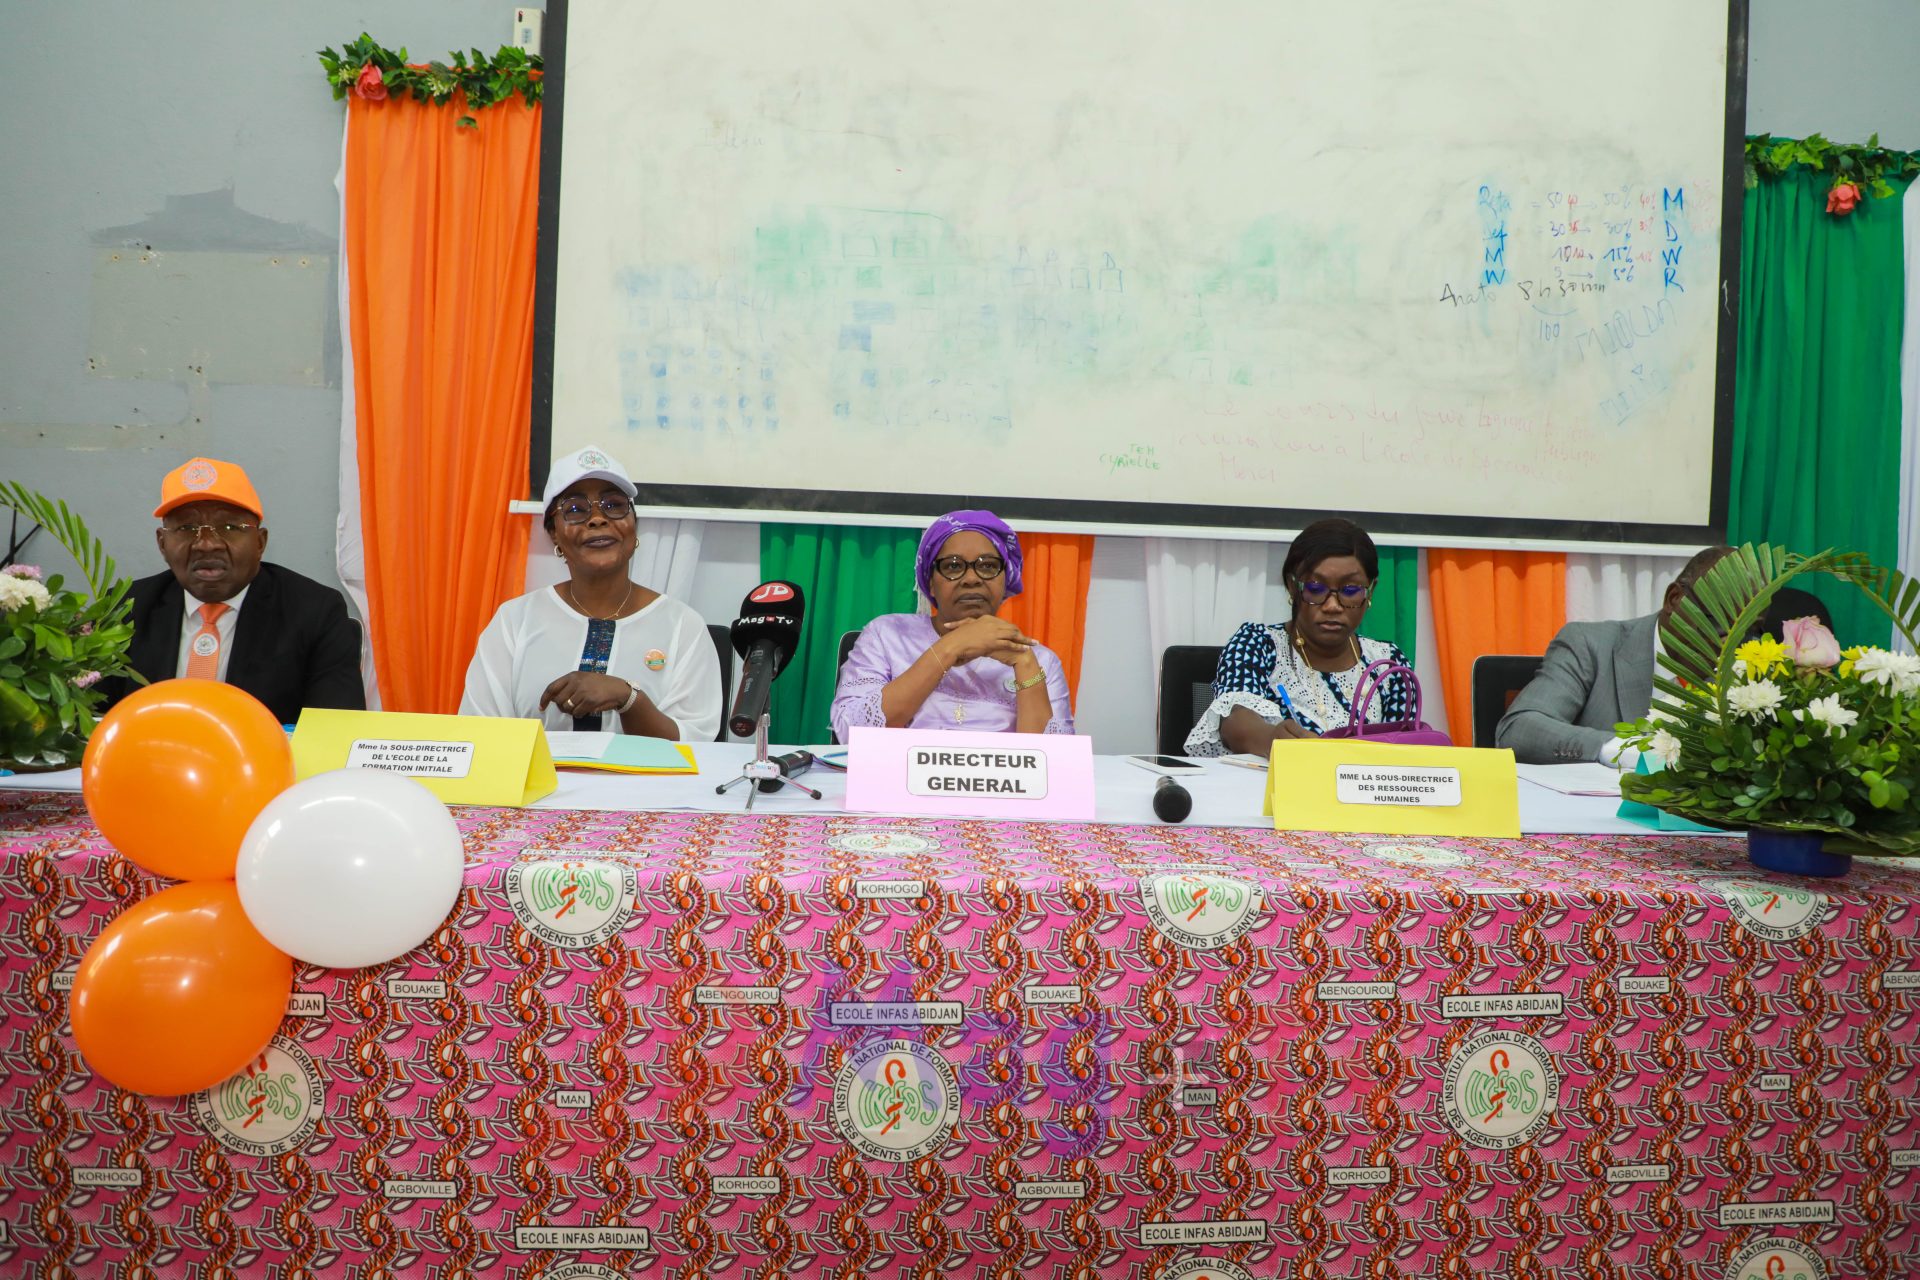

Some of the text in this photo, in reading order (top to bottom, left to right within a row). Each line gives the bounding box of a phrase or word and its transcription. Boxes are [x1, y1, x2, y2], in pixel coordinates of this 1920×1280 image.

[1662, 187, 1684, 212] M
[1662, 245, 1683, 266] W
[1664, 266, 1685, 293] R
[358, 743, 378, 751] Mme
[390, 744, 468, 753] SOUS-DIRECTRICE
[385, 754, 421, 762] L'ECOLE
[917, 752, 1037, 769] DIRECTEUR
[362, 764, 453, 773] FORMATION INITIALE
[1340, 773, 1359, 781] MME
[1375, 774, 1454, 783] SOUS-DIRECTRICE
[927, 776, 1027, 794] GENERAL
[1358, 784, 1436, 793] DES RESSOURCES
[1374, 795, 1421, 803] HUMAINES
[861, 884, 920, 894] KORHOGO
[514, 901, 630, 947] DES AGENTS DE SANTE
[1728, 898, 1828, 940] DES AGENTS DE SANTE
[1149, 905, 1259, 948] DES AGENTS DE SANTE
[394, 984, 441, 994] BOUAKE
[1319, 986, 1395, 995] ABENGOUROU
[1624, 980, 1665, 990] BOUAKE
[697, 989, 779, 1000] ABENGOUROU
[1031, 990, 1077, 999] BOUAKE
[288, 999, 320, 1011] IDJAN
[1447, 998, 1559, 1013] ECOLE INFAS ABIDJAN
[836, 1007, 958, 1020] ECOLE INFAS ABIDJAN
[271, 1034, 323, 1106] DE FORMATION
[1444, 1031, 1558, 1103] INSTITUT NATIONAL DE FORMATION
[836, 1041, 959, 1112] INSTITUT NATIONAL DE FORMATION
[1764, 1079, 1787, 1088] MAN
[560, 1095, 586, 1105] MAN
[1188, 1092, 1211, 1103] MAN
[202, 1110, 318, 1156] DES AGENTS DE SANTE
[1448, 1108, 1551, 1149] DES AGENTS DE SANTE
[840, 1119, 951, 1161] DES AGENTS DE SANTE
[78, 1172, 138, 1182] KORHOGO
[1332, 1171, 1387, 1181] KORHOGO
[1610, 1168, 1666, 1180] AGBOVILLE
[388, 1184, 452, 1195] AGBOVILLE
[718, 1180, 777, 1190] KORHOGO
[1019, 1185, 1081, 1196] AGBOVILLE
[1723, 1206, 1831, 1220] ECOLE INFAS ABIDJAN
[521, 1232, 645, 1245] ECOLE INFAS ABIDJAN
[1145, 1225, 1262, 1240] ECOLE INFAS ABIDJAN
[1739, 1238, 1788, 1262] NATIONAL
[1788, 1241, 1803, 1252] DE
[1216, 1260, 1233, 1273] DE
[598, 1266, 614, 1280] DE
